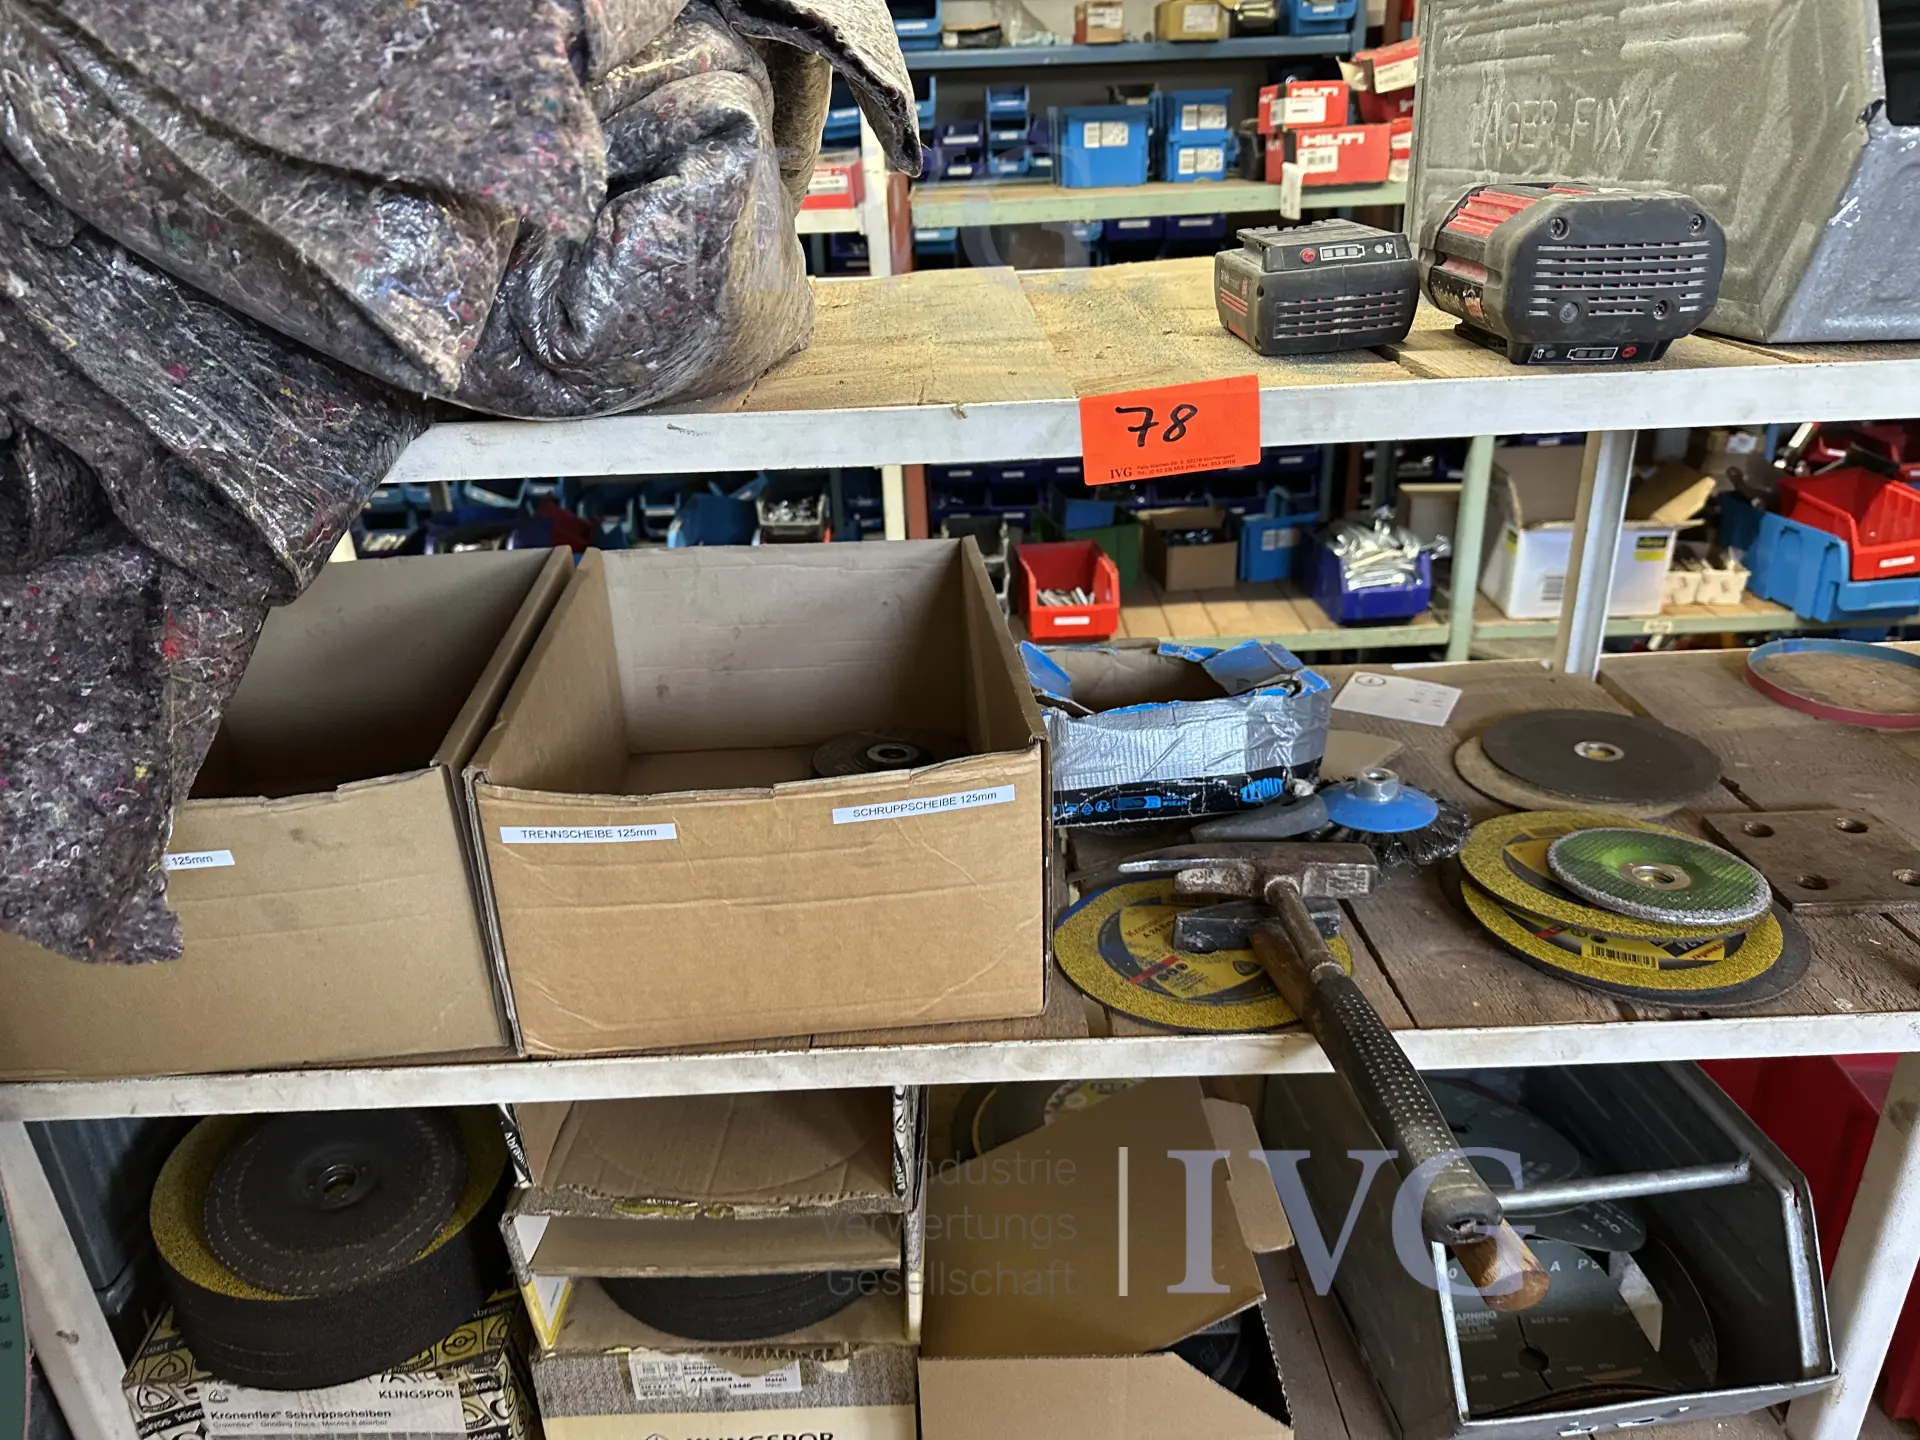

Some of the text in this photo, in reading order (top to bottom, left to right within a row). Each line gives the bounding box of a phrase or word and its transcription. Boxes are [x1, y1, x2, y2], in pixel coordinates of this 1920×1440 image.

[1291, 86, 1339, 97] HILTI
[1301, 132, 1366, 147] HILTI
[1115, 403, 1198, 448] 78
[1110, 467, 1132, 479] IVG
[853, 791, 997, 818] SCHRUPPSCHEIBE 125mm
[521, 827, 657, 839] TRENNSCHEIBE 125mm
[171, 855, 213, 866] 125mm
[1455, 1311, 1497, 1322] ARNING
[378, 1390, 454, 1400] KLINGSPOR
[285, 1410, 392, 1421] Schruppscheiben
